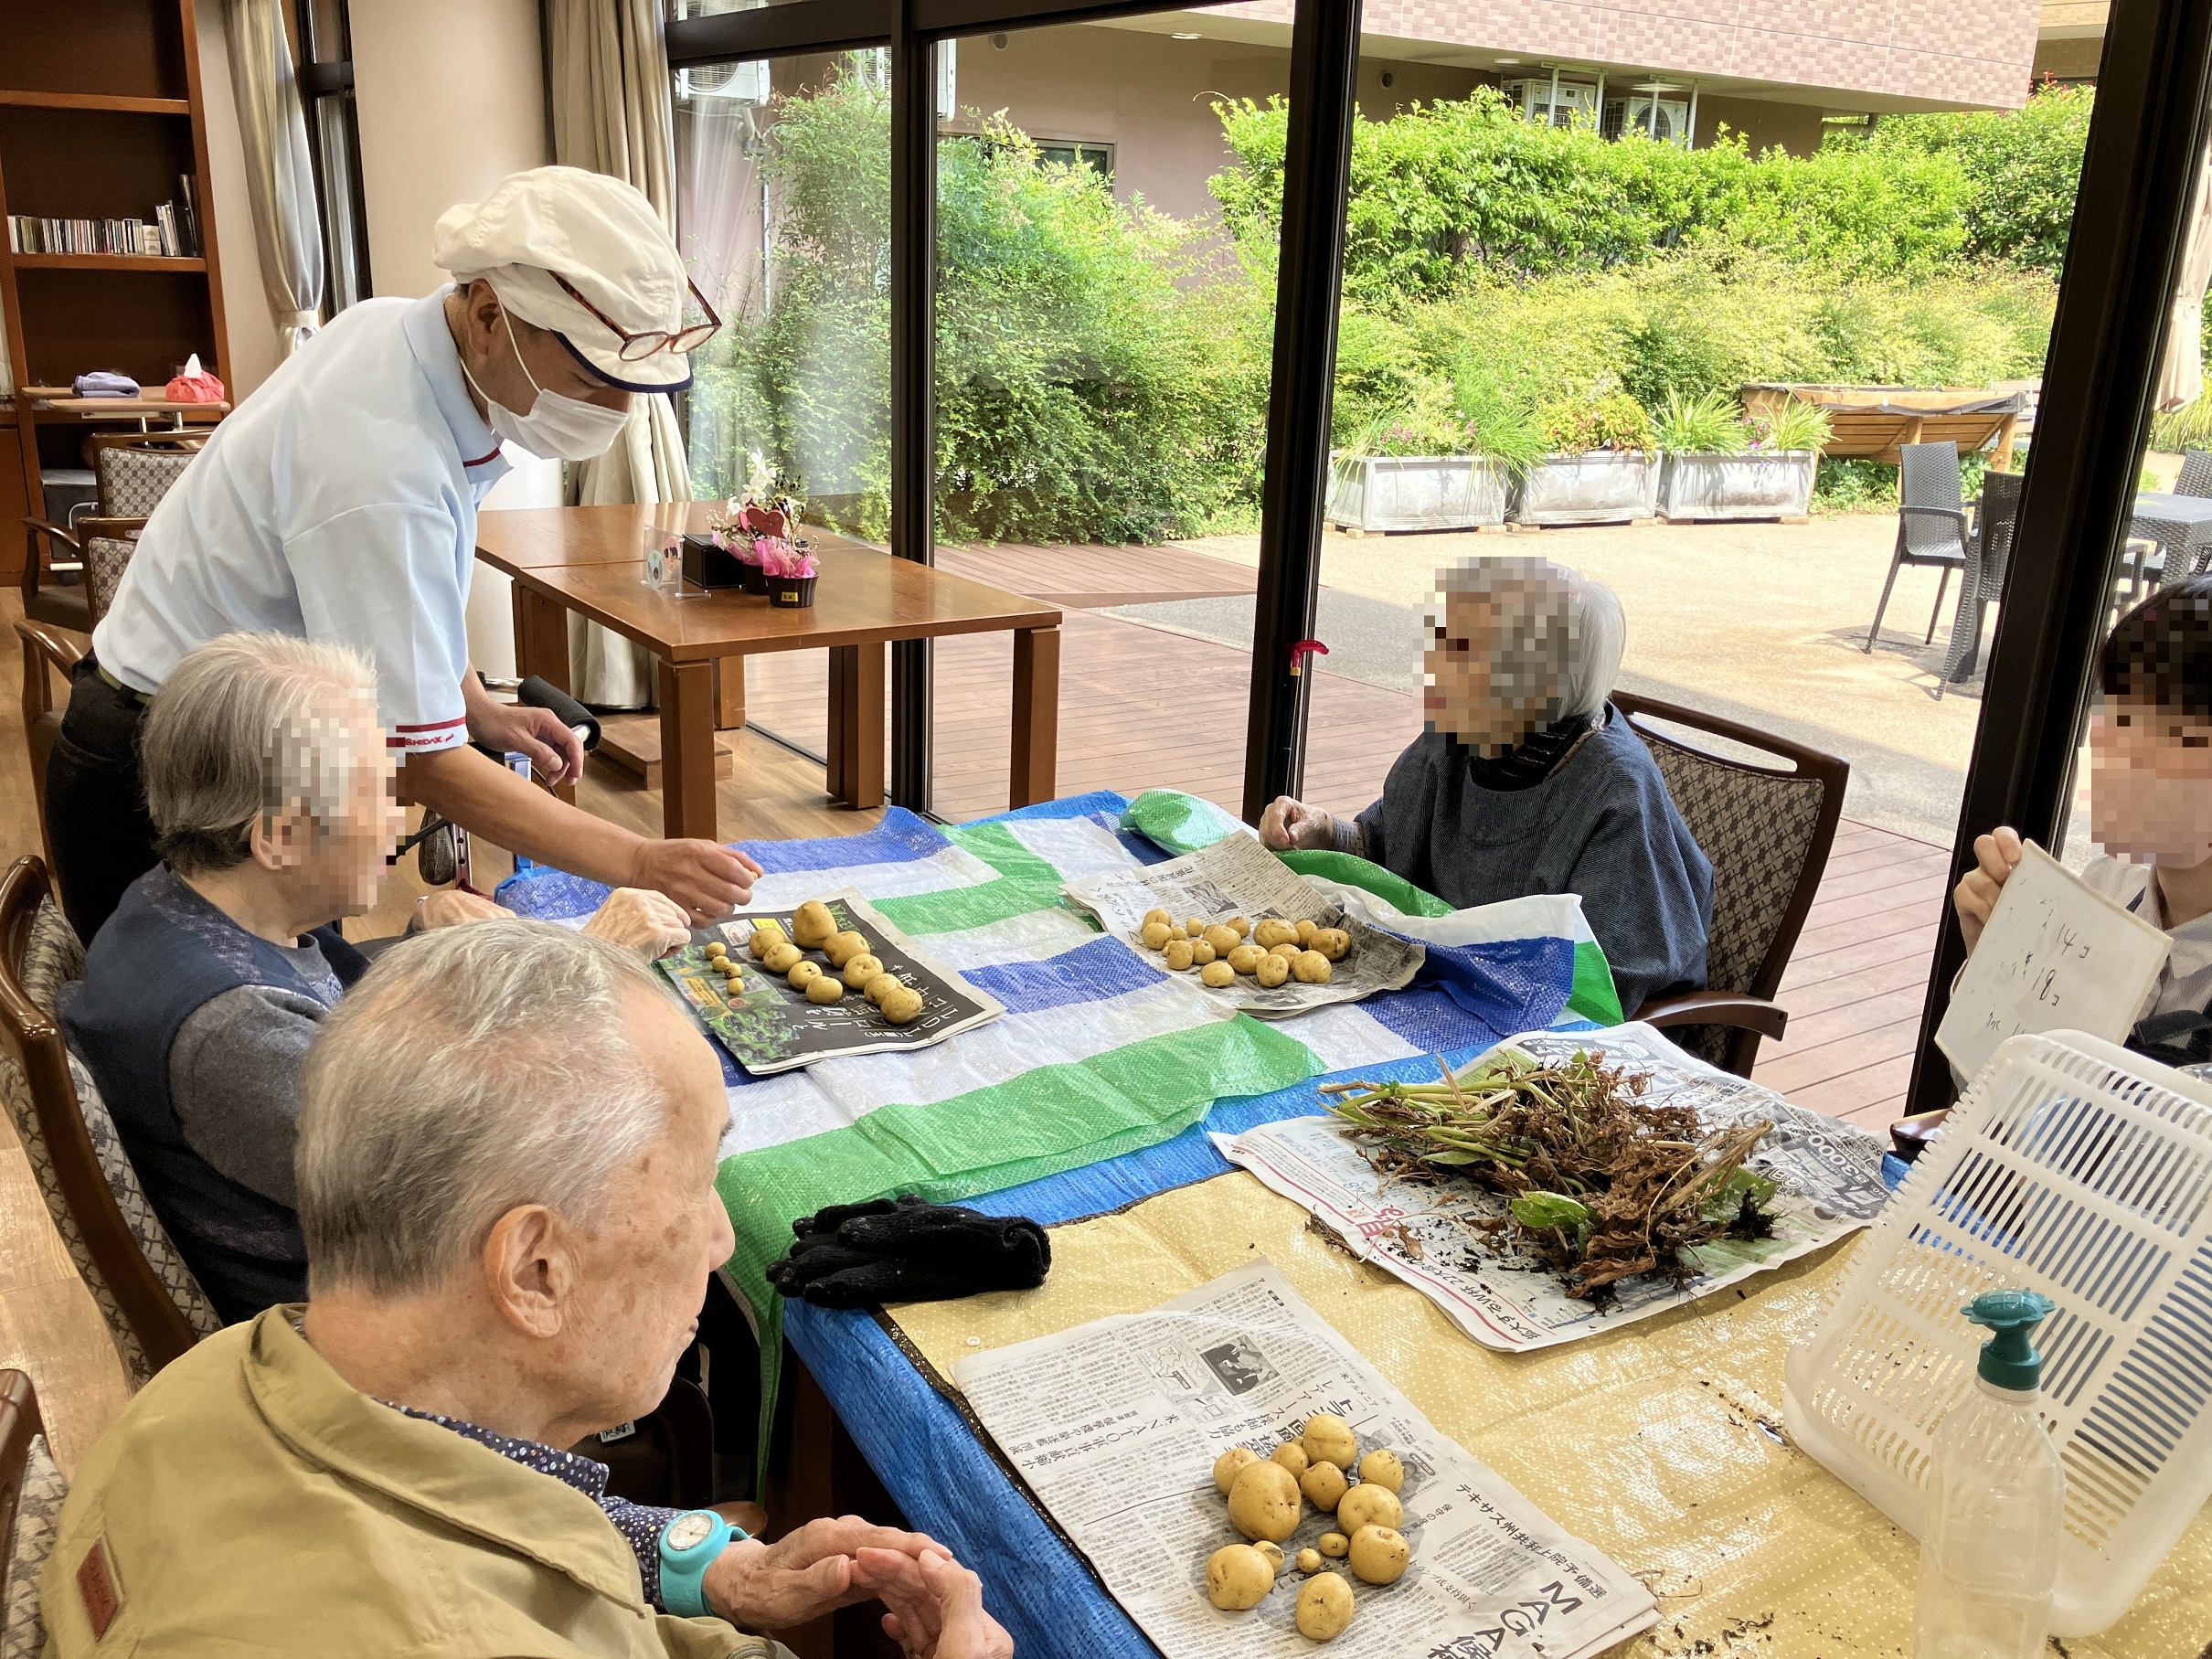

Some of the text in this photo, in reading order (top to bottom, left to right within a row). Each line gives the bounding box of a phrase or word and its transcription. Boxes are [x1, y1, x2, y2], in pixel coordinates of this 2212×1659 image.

[1206, 1380, 1333, 1439] レアアース採掘も協力
[1340, 1372, 1378, 1406] 米アルメニア
[1021, 1413, 1179, 1470] 米、NATO軍事貢献縮小
[1456, 1484, 1608, 1601] テキサス州共和上院予備選
